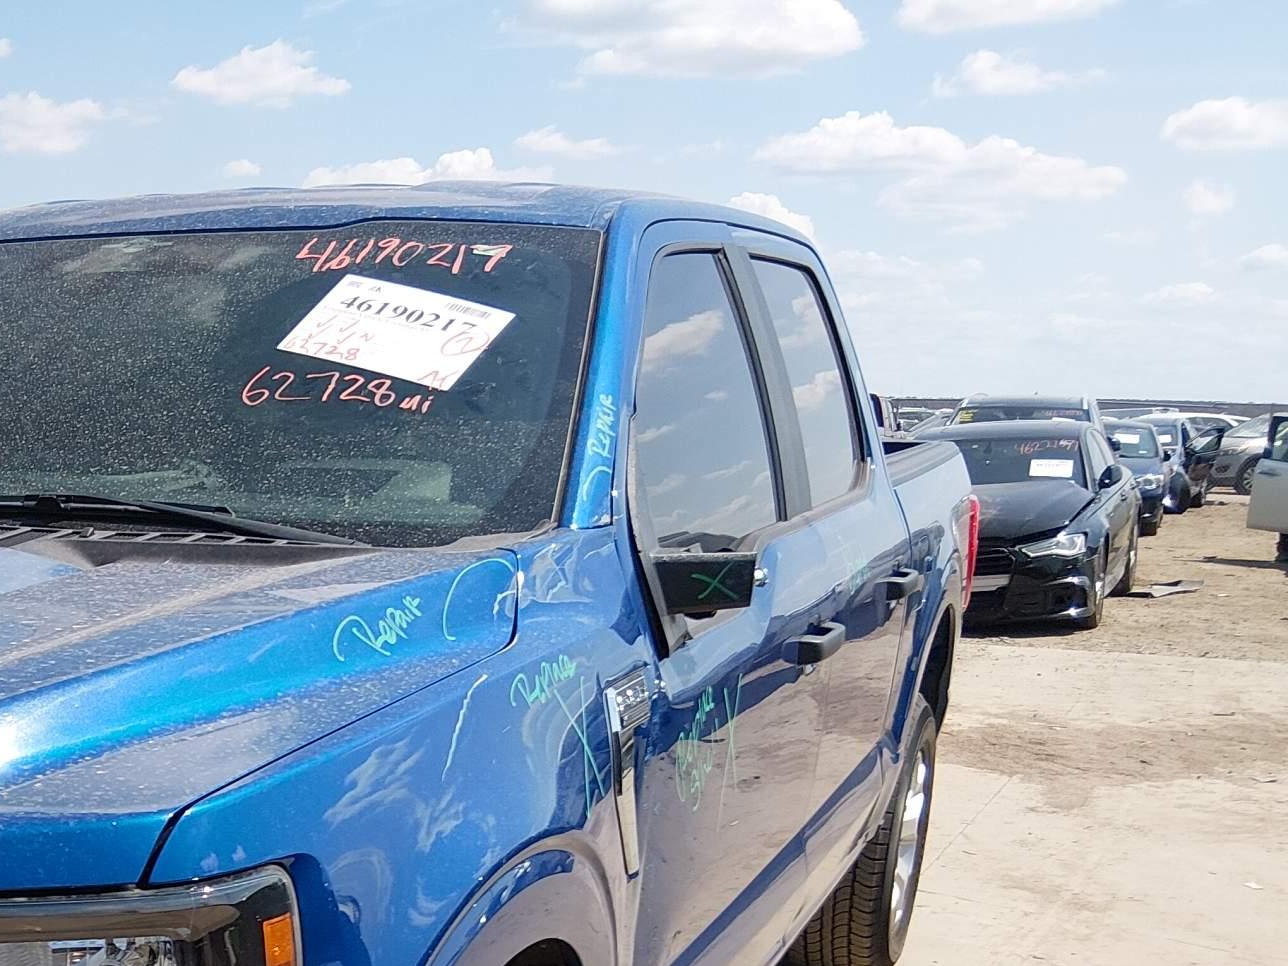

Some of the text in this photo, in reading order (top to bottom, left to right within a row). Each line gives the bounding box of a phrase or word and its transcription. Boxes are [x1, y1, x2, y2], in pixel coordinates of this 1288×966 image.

[296, 237, 513, 274] 46190217
[340, 296, 478, 332] 46190217
[241, 366, 397, 407] 62728
